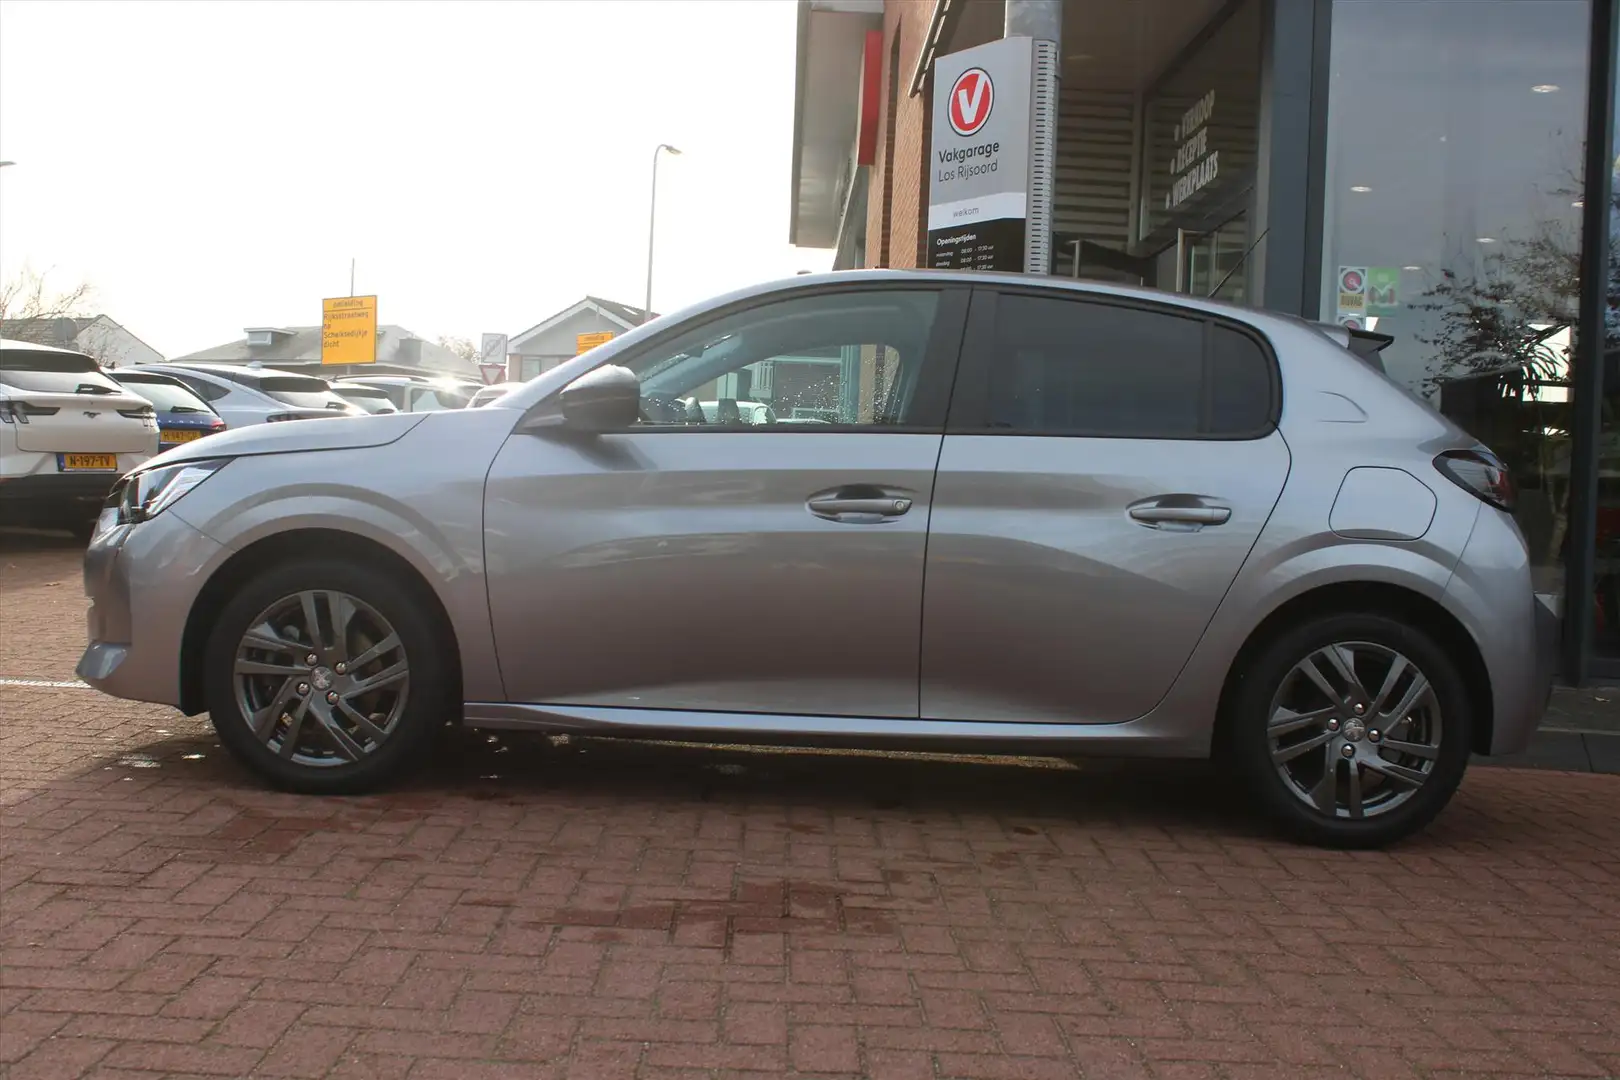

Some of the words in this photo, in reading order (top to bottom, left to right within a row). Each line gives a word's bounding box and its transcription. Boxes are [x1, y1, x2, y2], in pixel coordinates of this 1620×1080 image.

[938, 142, 1000, 164] Vakgarage
[1177, 126, 1207, 174] RECEPTIE
[938, 169, 955, 182] Los
[957, 159, 998, 180] Rijsoord
[1172, 150, 1219, 208] WERKPLAATS
[953, 206, 980, 218] welkom
[936, 234, 976, 246] Openingstijden
[323, 339, 340, 348] dicht
[70, 455, 110, 467] N-197-TV
